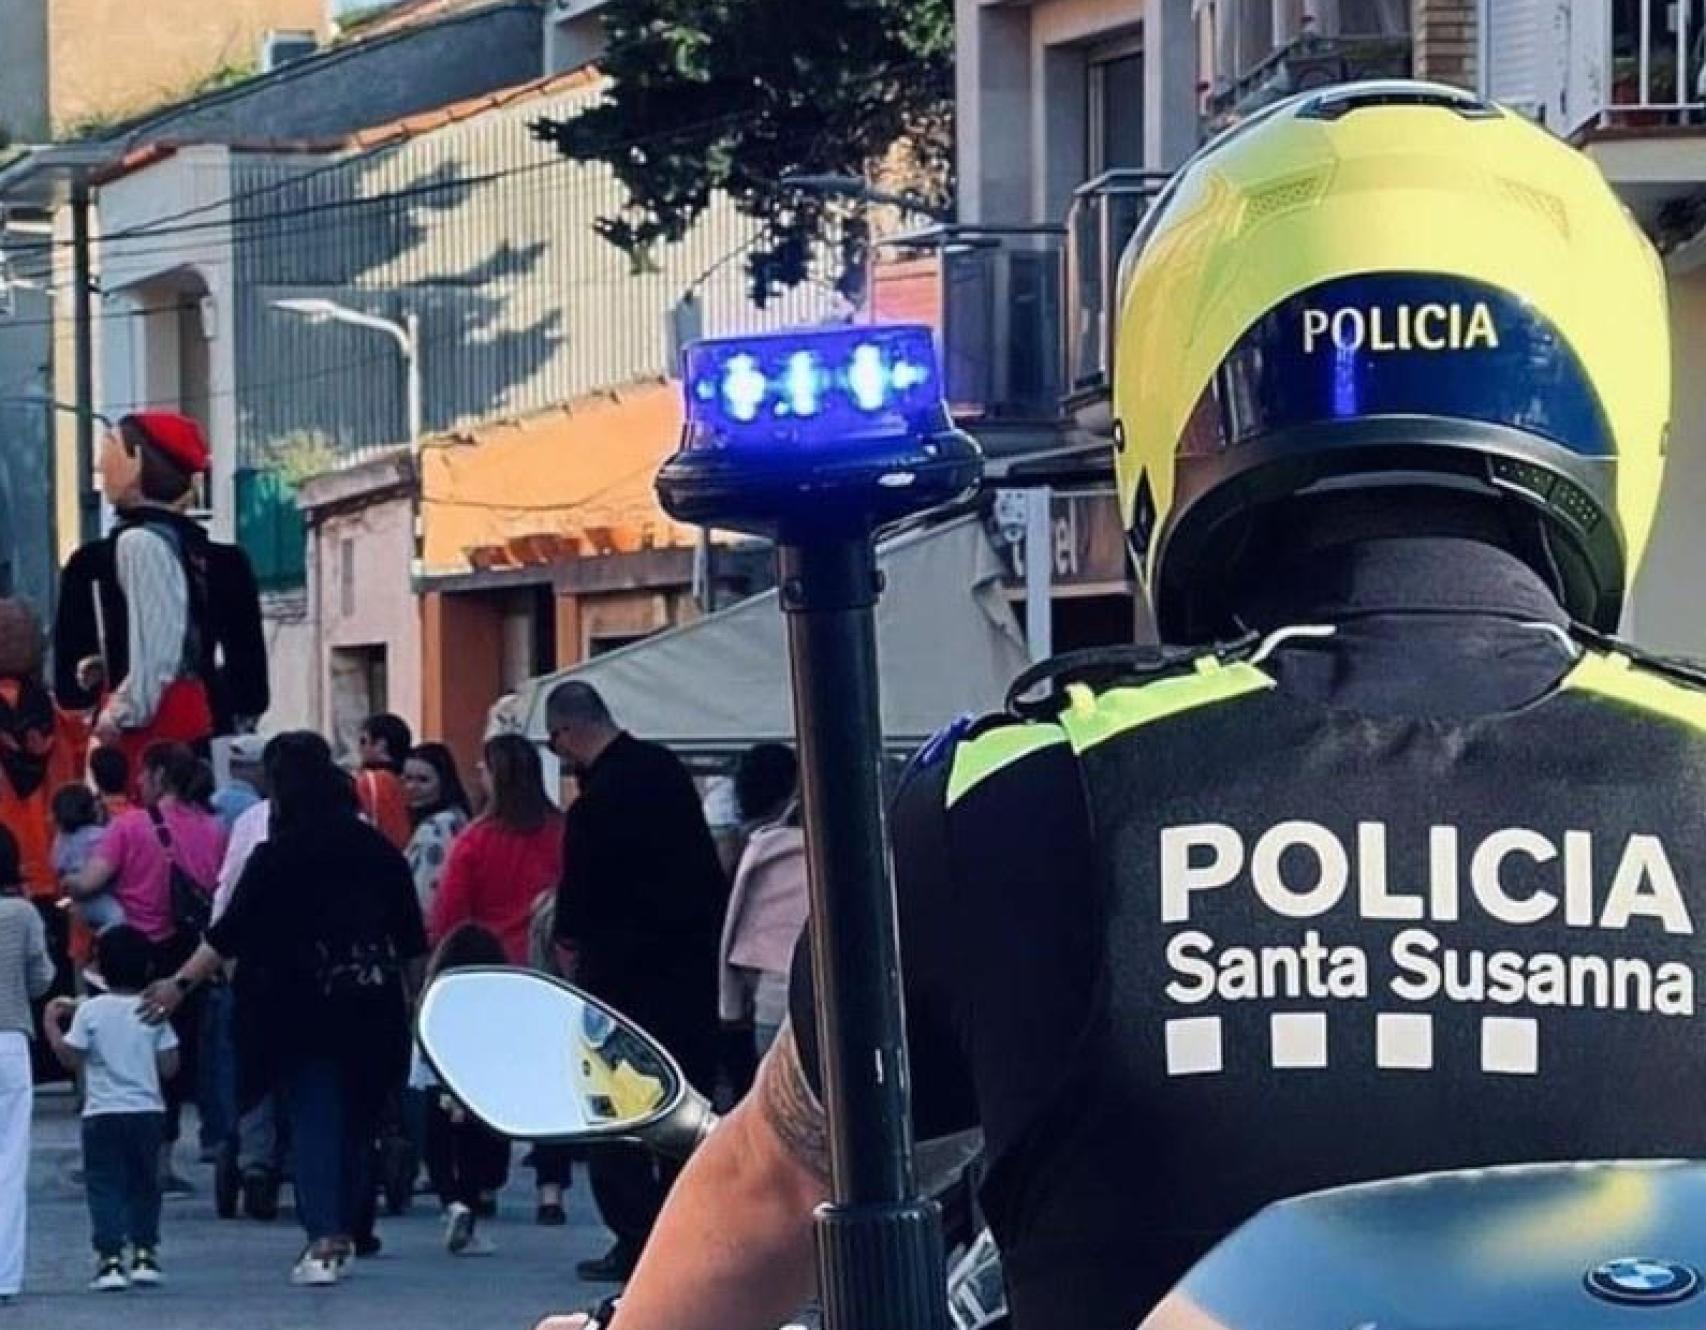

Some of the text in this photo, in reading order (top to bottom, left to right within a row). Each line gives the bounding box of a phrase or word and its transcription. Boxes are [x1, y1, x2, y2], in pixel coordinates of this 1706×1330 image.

[1303, 302, 1499, 353] POLICIA
[1160, 821, 1694, 934] POLICIA
[1165, 929, 1694, 1016] Santa Susanna
